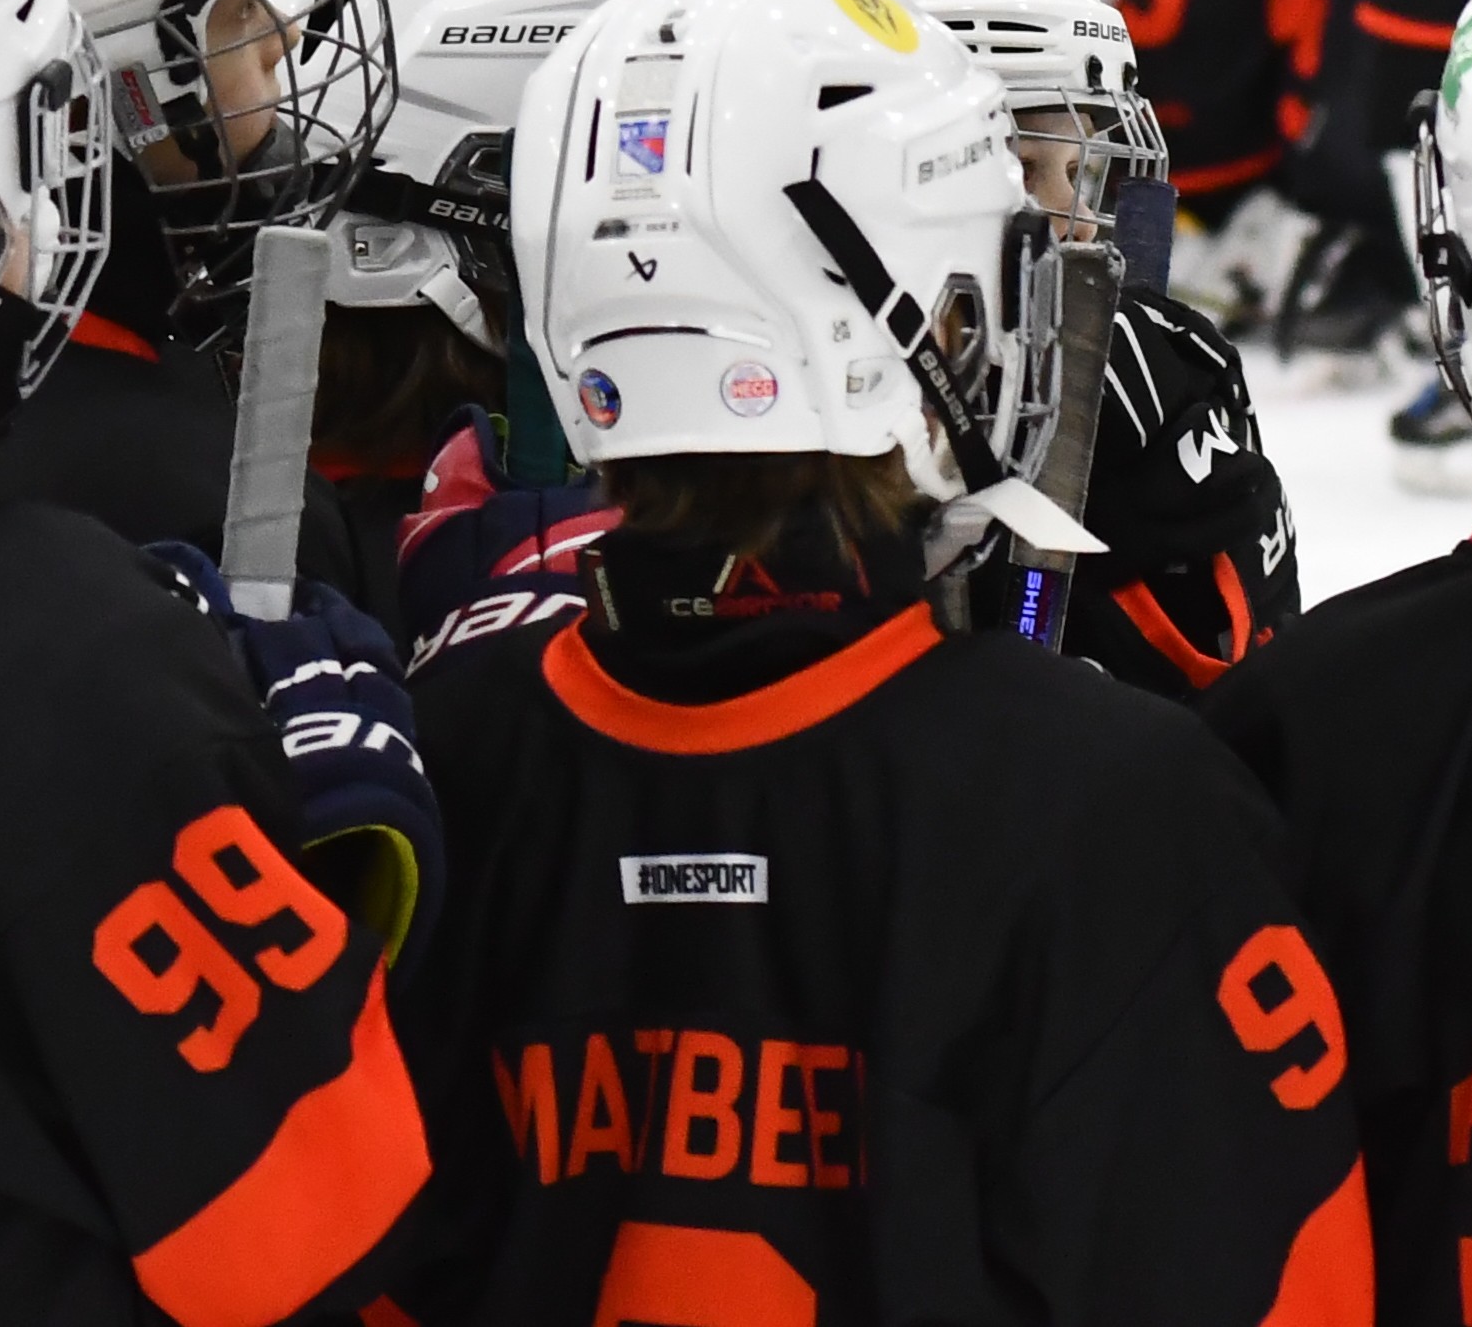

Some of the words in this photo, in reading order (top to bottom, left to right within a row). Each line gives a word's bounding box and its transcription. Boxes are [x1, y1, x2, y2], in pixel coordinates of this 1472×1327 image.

[1019, 571, 1042, 640] SHIE
[93, 805, 347, 1073] 99
[1217, 924, 1347, 1110] 9
[492, 1028, 867, 1188] МАТВЕЕ
